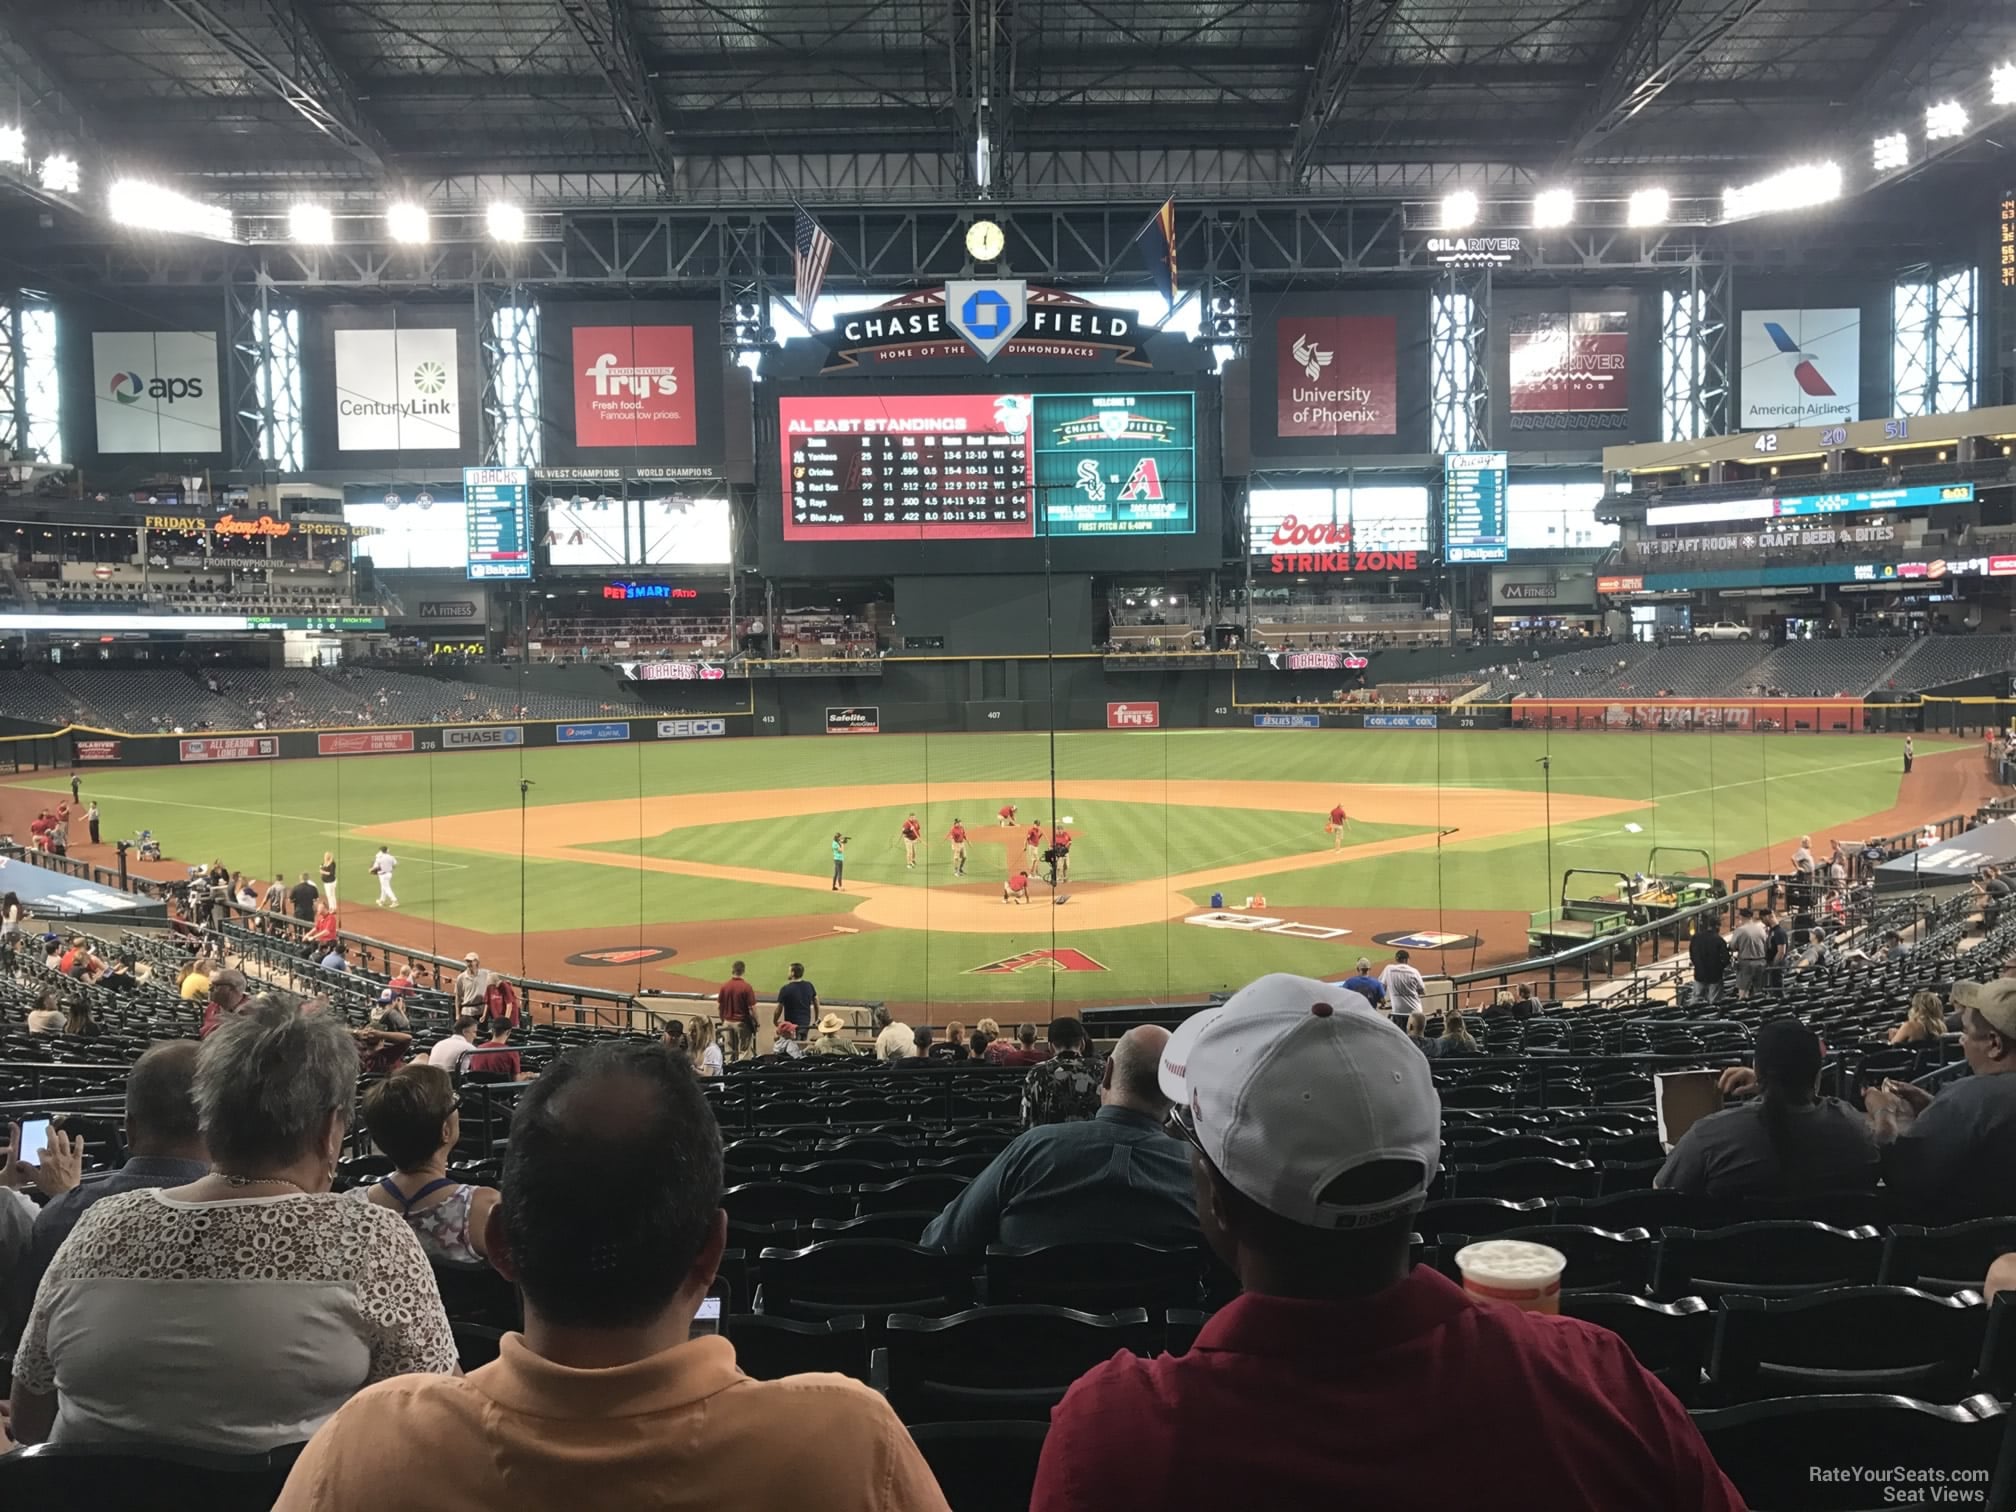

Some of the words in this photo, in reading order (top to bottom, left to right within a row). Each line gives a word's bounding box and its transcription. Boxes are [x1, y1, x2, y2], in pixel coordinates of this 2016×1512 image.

[845, 313, 940, 341] CHASE
[1034, 312, 1128, 337] FIELD
[880, 349, 913, 360] HOME
[921, 347, 935, 355] OF
[944, 346, 966, 354] THE
[1008, 345, 1095, 357] DIAMONDBACKS
[585, 353, 678, 399] fry's
[148, 375, 203, 403] aps
[1528, 383, 1605, 391] CASINOS
[1292, 387, 1371, 405] University
[340, 398, 451, 418] CenturyLink
[592, 401, 618, 410] Fresh
[620, 401, 644, 410] food.
[1750, 403, 1805, 416] American
[1807, 401, 1851, 415] Airlines
[601, 411, 634, 419] Famous
[637, 411, 651, 419] low
[1293, 407, 1309, 422] of
[1313, 407, 1375, 422] Phoenix
[788, 418, 812, 432] AL
[813, 418, 861, 432] EAST
[863, 417, 967, 432] STANDINGS
[1065, 422, 1099, 434] CHASE
[1129, 422, 1164, 433] FIELD
[1885, 419, 1908, 440] 51
[1754, 433, 1777, 452] 42
[1820, 426, 1846, 446] 20
[993, 451, 1005, 459] W1
[534, 470, 545, 478] NL
[547, 469, 569, 478] WEST
[572, 469, 620, 477] CHAMPIONS
[637, 468, 664, 477] WORLD
[666, 468, 712, 477] CHAMPIONS
[994, 466, 1004, 474] L1
[809, 499, 827, 508] Rays
[995, 497, 1004, 505] L1
[810, 513, 827, 522] Blue
[828, 514, 844, 523] Jays
[994, 511, 1006, 520] W1
[145, 516, 206, 529] FRIDAY'S
[298, 523, 347, 536] SPORTS
[1271, 514, 1353, 546] Coors
[1760, 532, 1799, 547] CRAFT
[1802, 530, 1835, 545] BEER
[1855, 526, 1894, 541] BITES
[1271, 552, 1349, 573] STRIKE
[1354, 550, 1417, 571] ZONE
[672, 588, 697, 598] PATIO
[1524, 588, 1556, 597] FITNESS
[440, 607, 473, 616] FITNESS
[829, 713, 866, 722] Safelite
[987, 711, 1001, 720] 407
[1113, 704, 1154, 725] fry's
[1214, 707, 1227, 715] 413
[762, 715, 775, 724] 413
[659, 722, 721, 737] GEICO
[210, 740, 223, 749] ALL
[225, 738, 254, 749] SEASON
[450, 730, 501, 744] CHASE
[420, 741, 436, 750] 376
